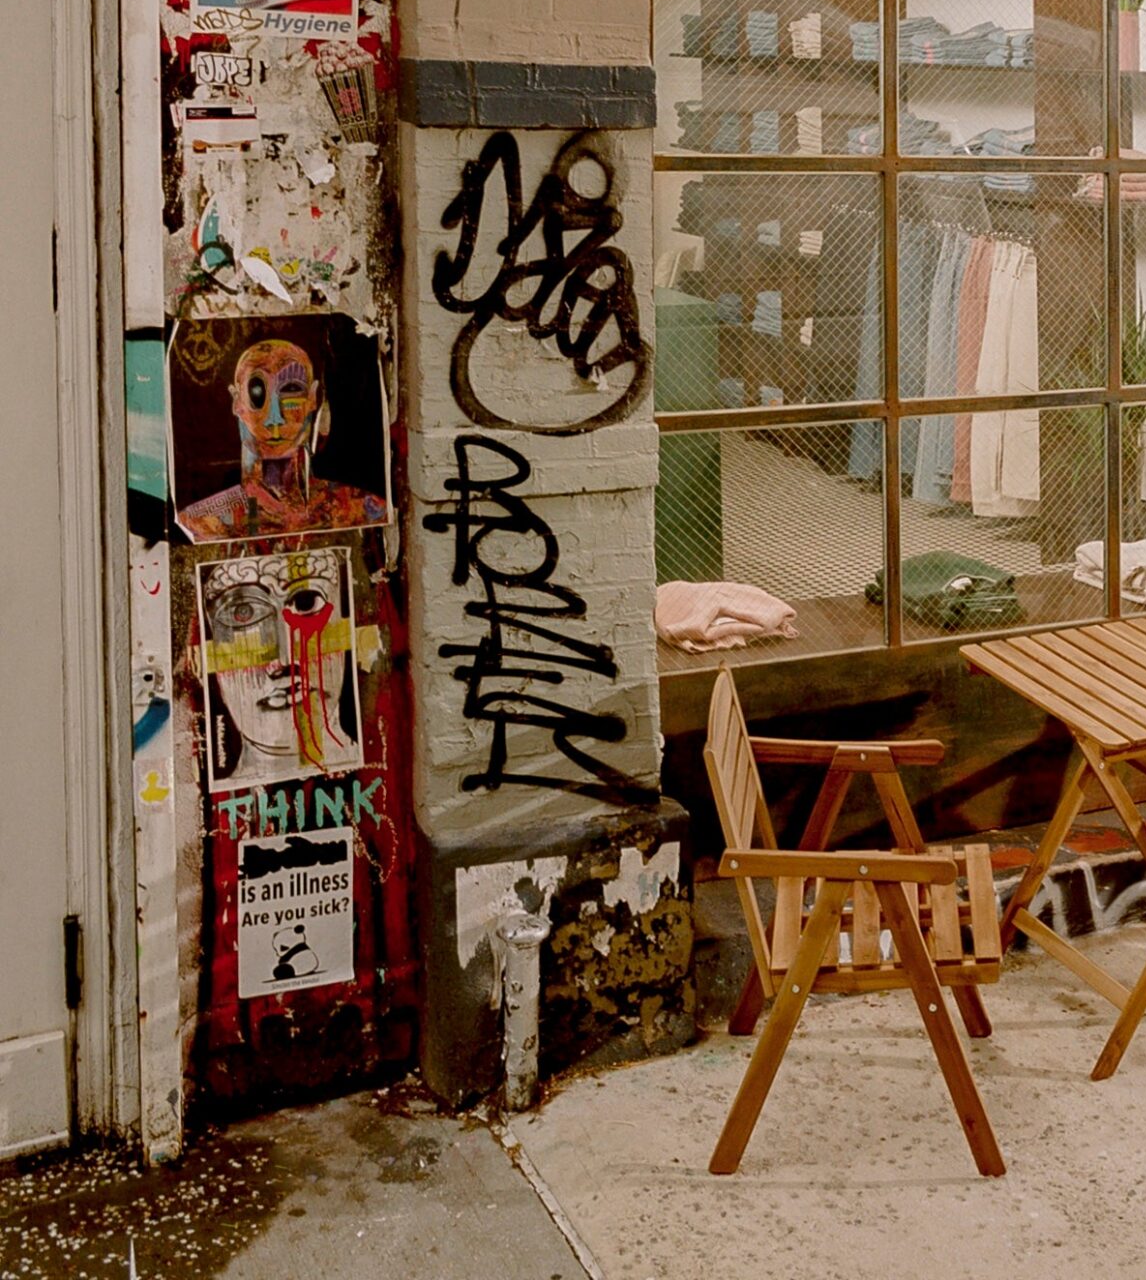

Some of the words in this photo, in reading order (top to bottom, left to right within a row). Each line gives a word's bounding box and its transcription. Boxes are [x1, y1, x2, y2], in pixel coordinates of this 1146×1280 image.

[264, 12, 352, 35] Hygiene
[218, 776, 383, 841] THINK
[241, 880, 257, 905] is
[261, 881, 284, 901] an
[290, 871, 350, 898] illness
[241, 911, 270, 928] Are
[274, 907, 306, 926] you
[310, 896, 350, 918] sick?
